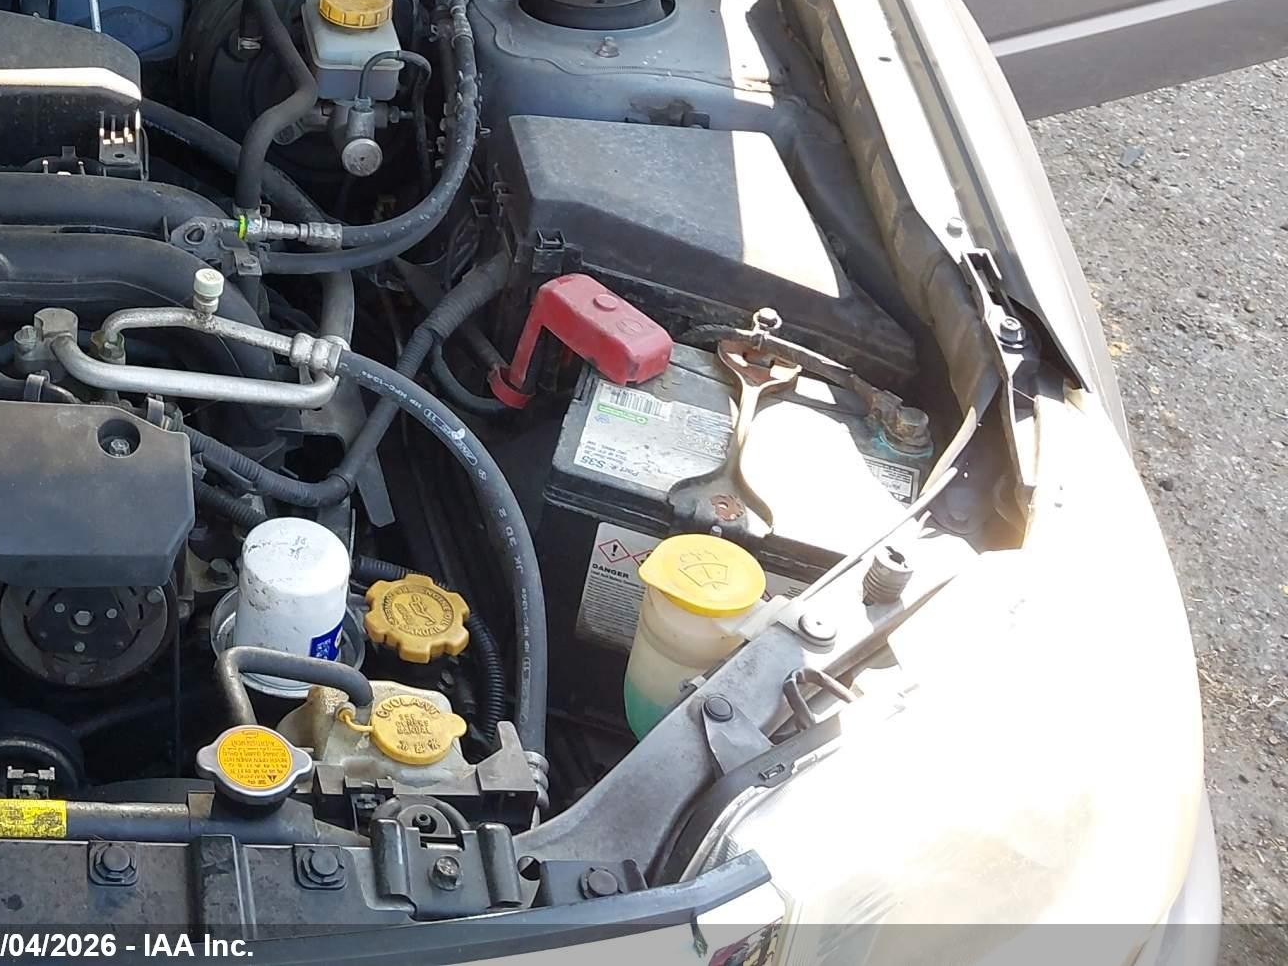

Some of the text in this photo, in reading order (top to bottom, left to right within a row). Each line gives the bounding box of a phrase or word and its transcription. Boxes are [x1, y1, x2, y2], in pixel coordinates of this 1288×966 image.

[581, 454, 605, 469] S35
[592, 563, 630, 579] DANGER
[376, 697, 441, 718] COOLANT
